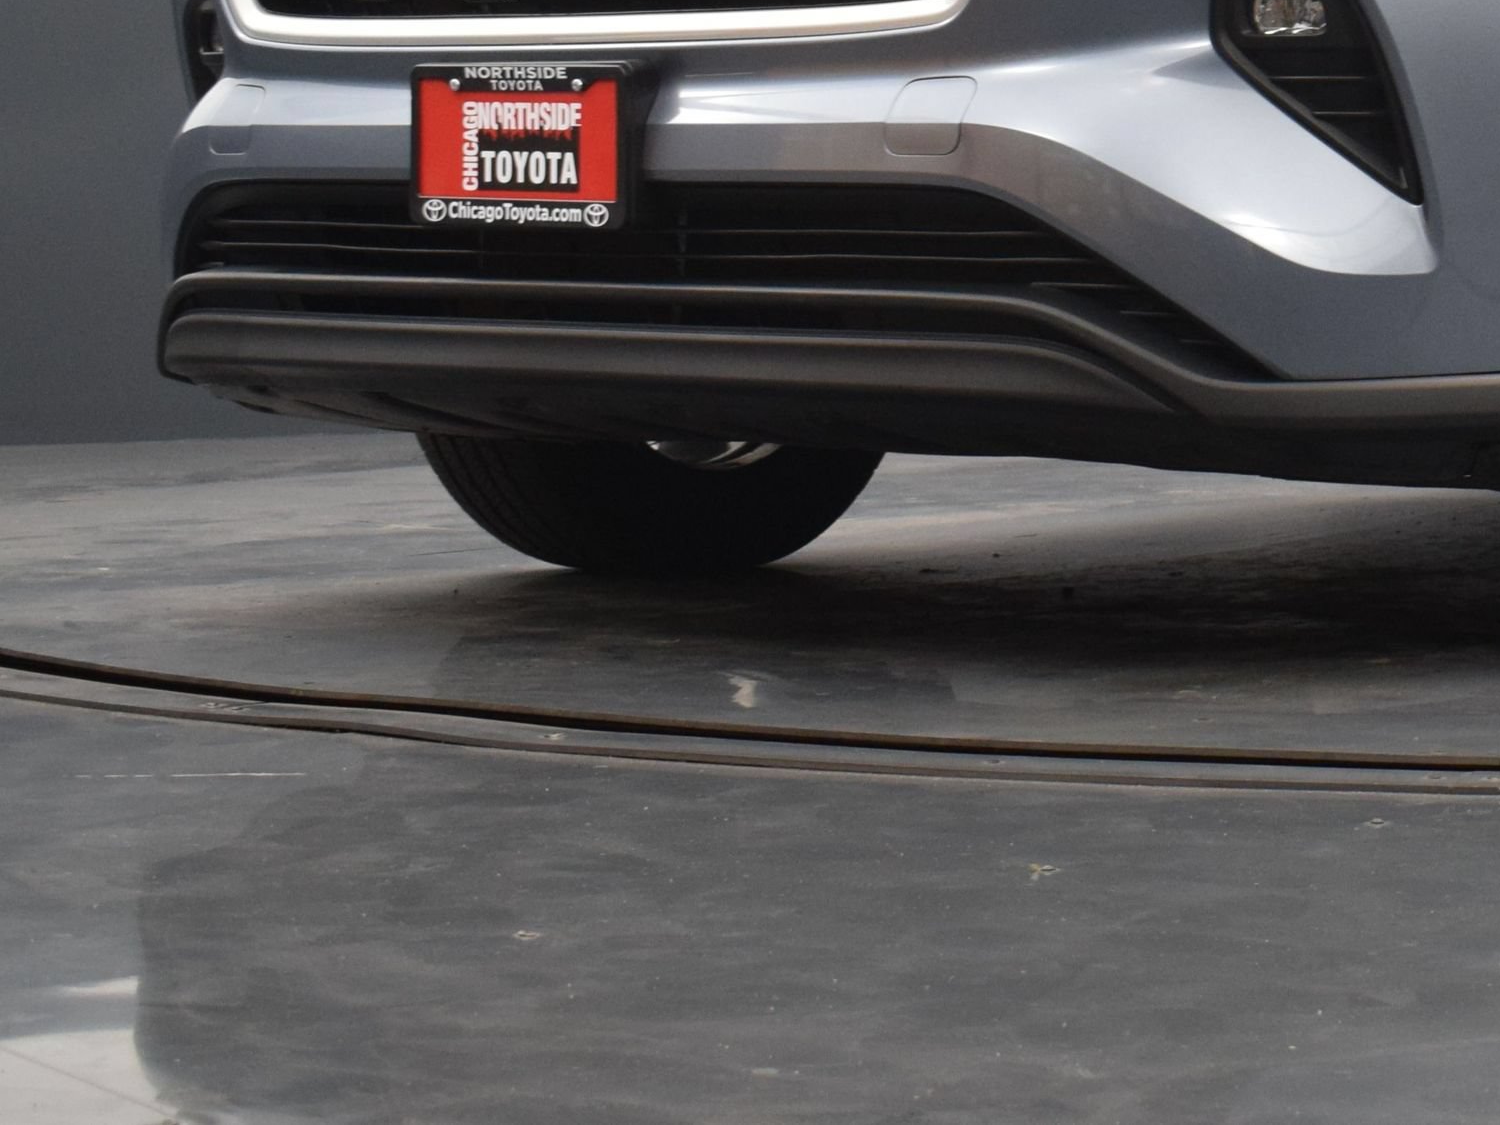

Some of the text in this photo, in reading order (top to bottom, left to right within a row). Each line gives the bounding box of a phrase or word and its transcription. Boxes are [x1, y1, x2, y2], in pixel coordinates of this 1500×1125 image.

[464, 66, 567, 79] NORTHSIDE
[490, 79, 544, 91] TOYOTA
[479, 101, 582, 131] NORTHSIDE
[462, 101, 479, 192] CHICAGO
[480, 150, 577, 184] TOYOTA
[449, 201, 582, 223] ChicagoToyota.com
